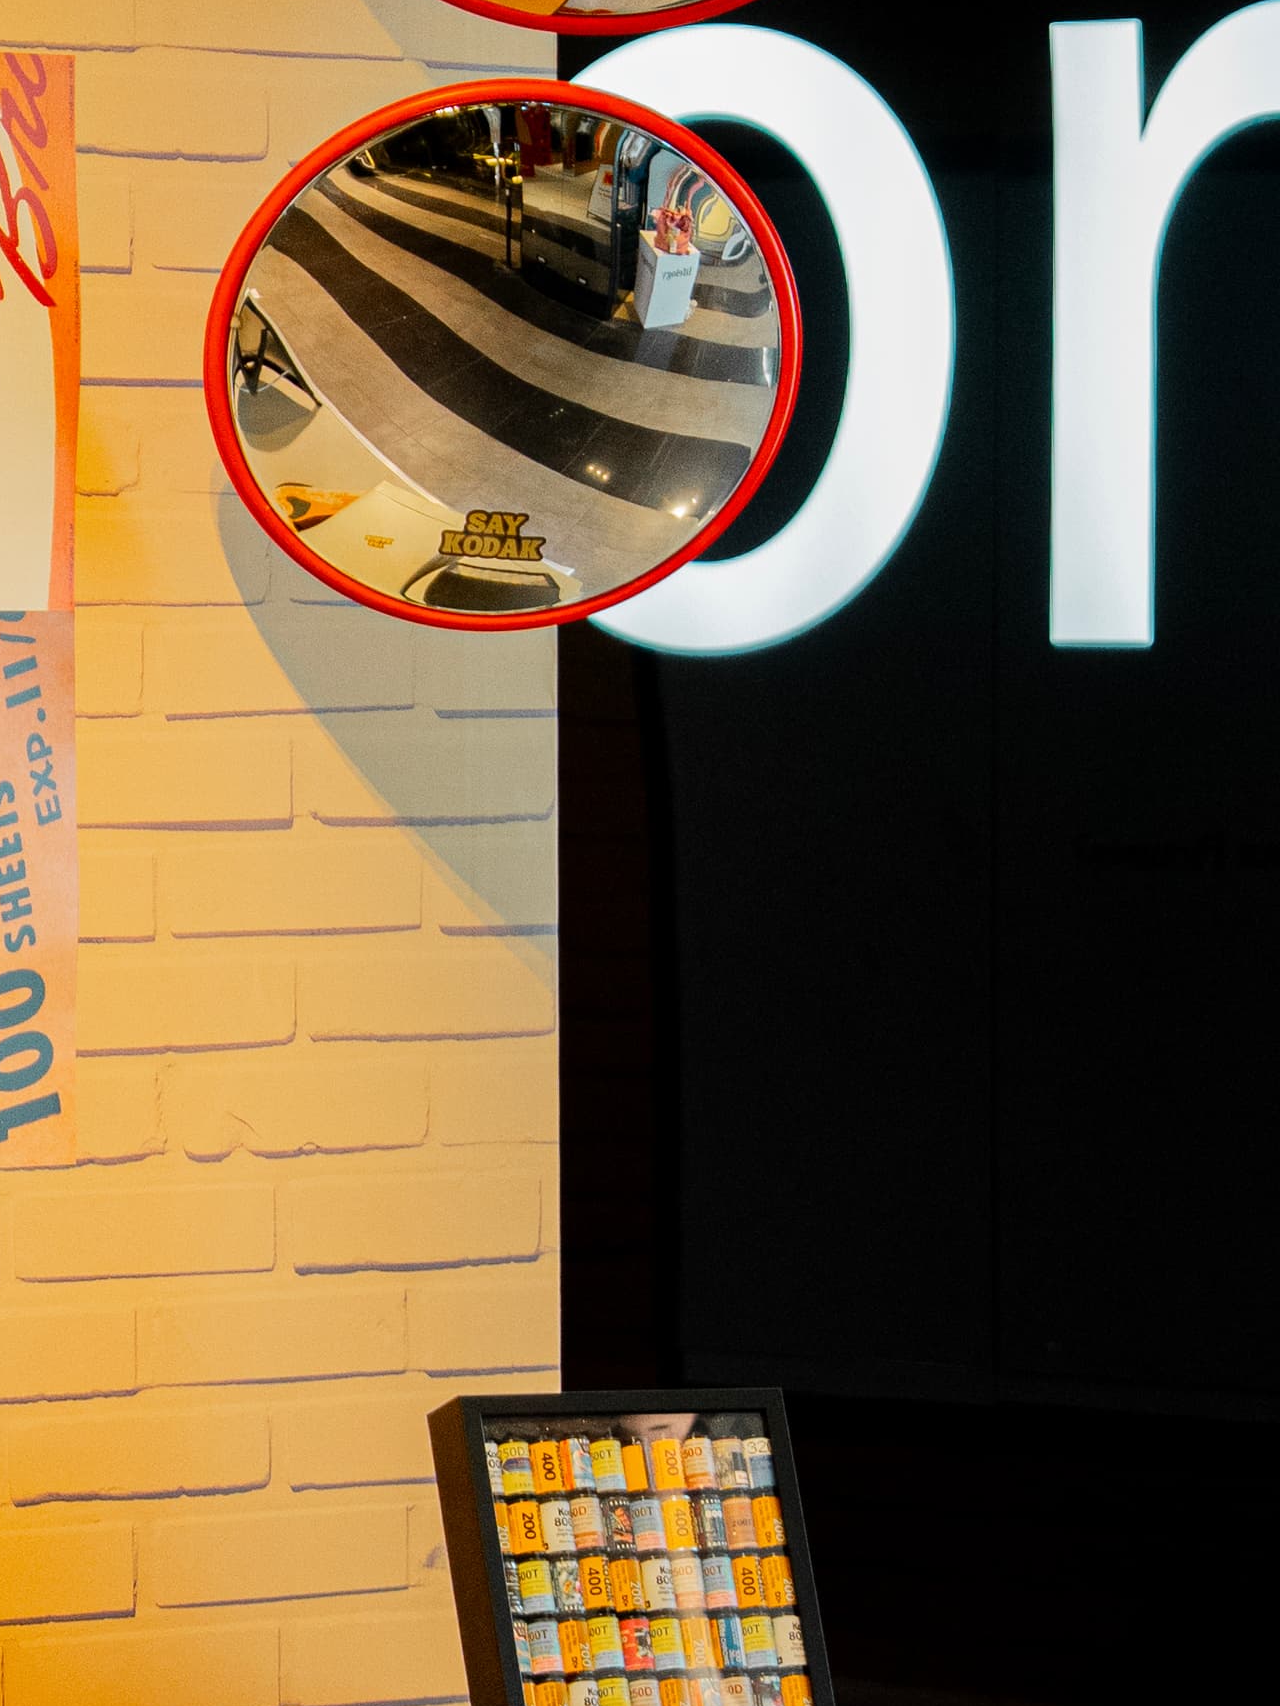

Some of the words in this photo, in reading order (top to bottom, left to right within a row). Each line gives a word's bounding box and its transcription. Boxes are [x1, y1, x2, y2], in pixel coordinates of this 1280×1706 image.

[466, 511, 528, 535] SAY
[441, 531, 545, 560] KODAK
[542, 1453, 556, 1480] 400
[664, 1449, 679, 1476] 200
[521, 1512, 537, 1540] 200
[674, 1508, 689, 1537] 400
[773, 1518, 786, 1542] 200
[588, 1568, 603, 1596] 400
[741, 1567, 756, 1596] 400
[783, 1578, 795, 1603] 200
